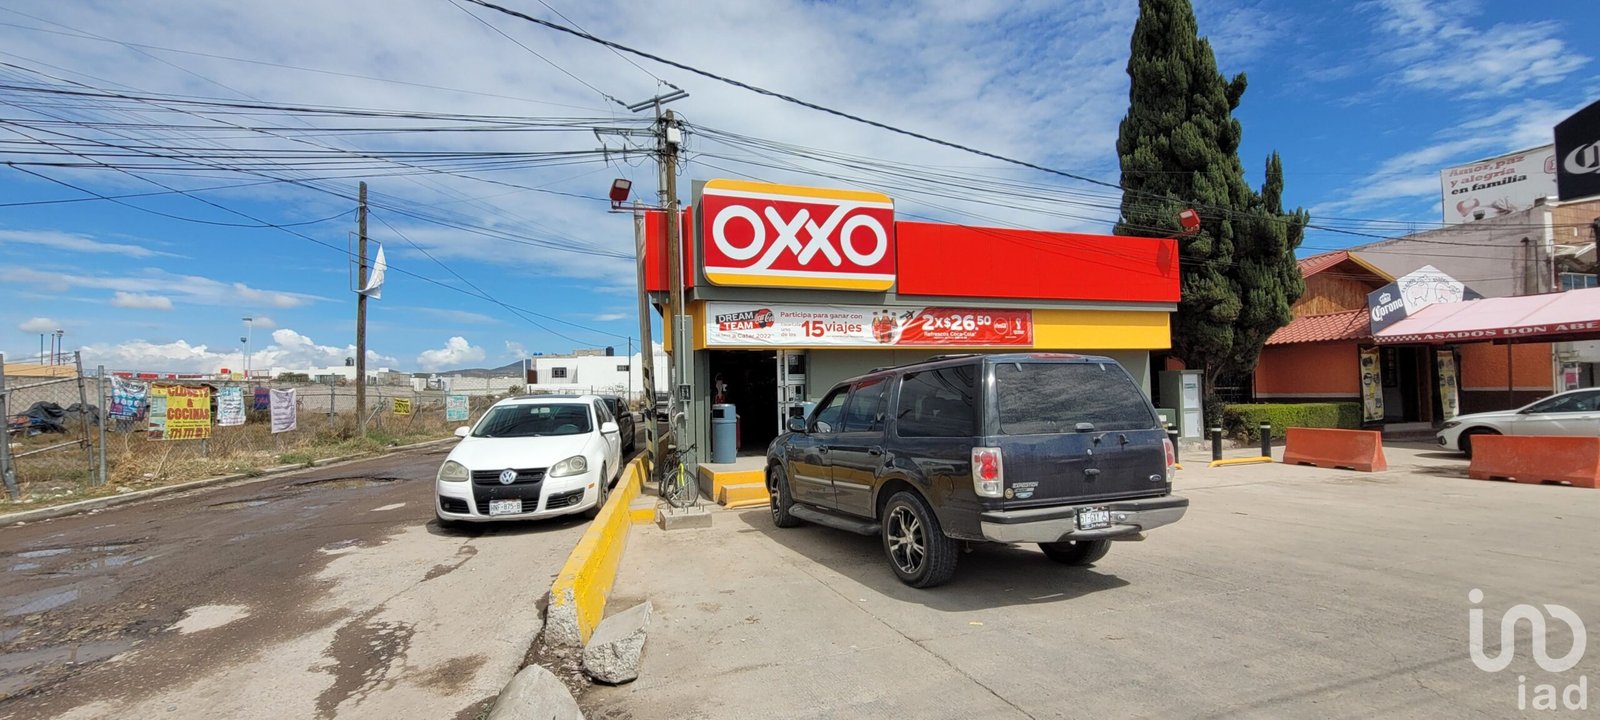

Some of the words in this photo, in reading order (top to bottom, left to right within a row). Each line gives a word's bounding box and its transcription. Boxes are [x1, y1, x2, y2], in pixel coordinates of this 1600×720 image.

[1450, 162, 1493, 177] Amor,
[1495, 154, 1526, 170] paz
[1450, 179, 1459, 187] y
[1451, 186, 1469, 195] en
[1471, 174, 1528, 192] familia
[712, 204, 888, 267] OXXO
[718, 311, 754, 322] DREAM
[780, 311, 811, 319] Participa
[1371, 298, 1404, 322] Corona
[724, 321, 753, 330] TEAM
[801, 320, 825, 337] 15
[825, 321, 862, 334] viajes
[1423, 329, 1496, 340] ASADOS
[1503, 325, 1547, 335] DON
[1555, 321, 1599, 331] ABE
[167, 407, 210, 421] COCINAS
